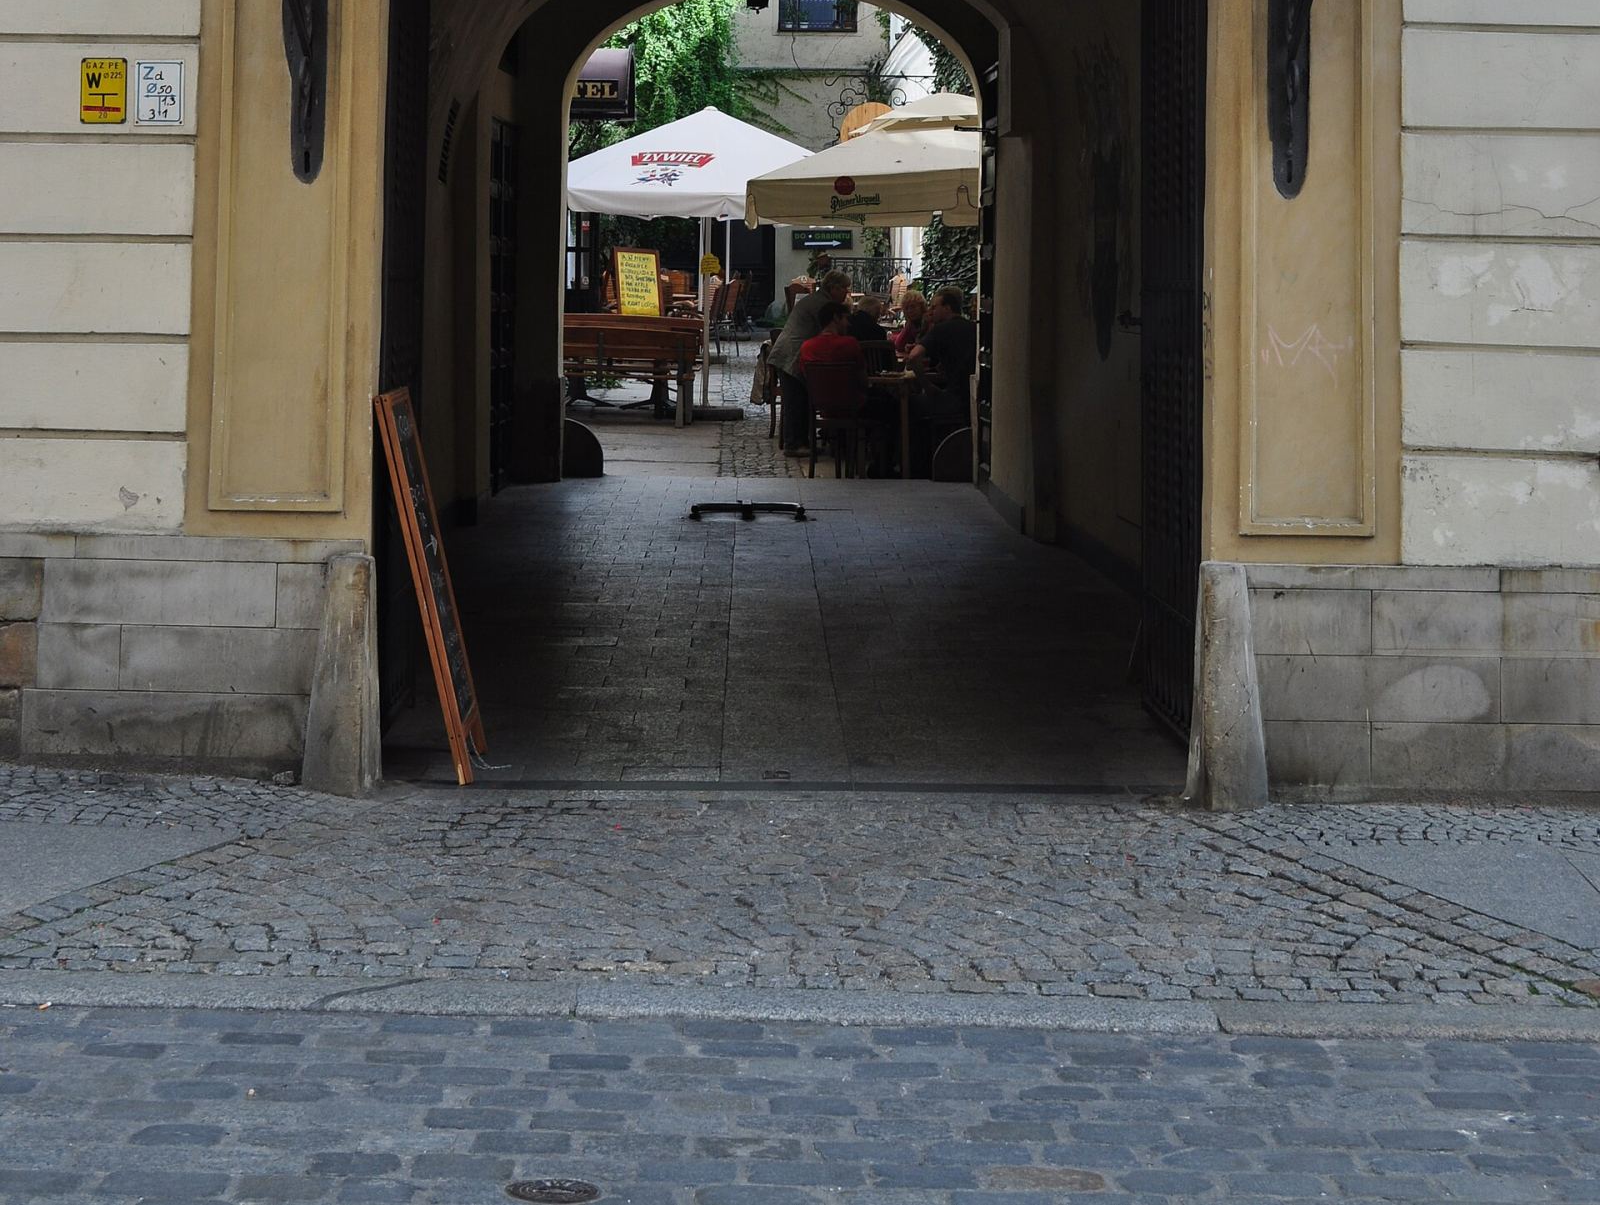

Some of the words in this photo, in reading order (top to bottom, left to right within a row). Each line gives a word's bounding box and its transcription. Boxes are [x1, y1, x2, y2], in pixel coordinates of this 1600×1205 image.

[86, 61, 104, 69] GAZ
[108, 61, 120, 69] PE
[86, 72, 101, 88] W
